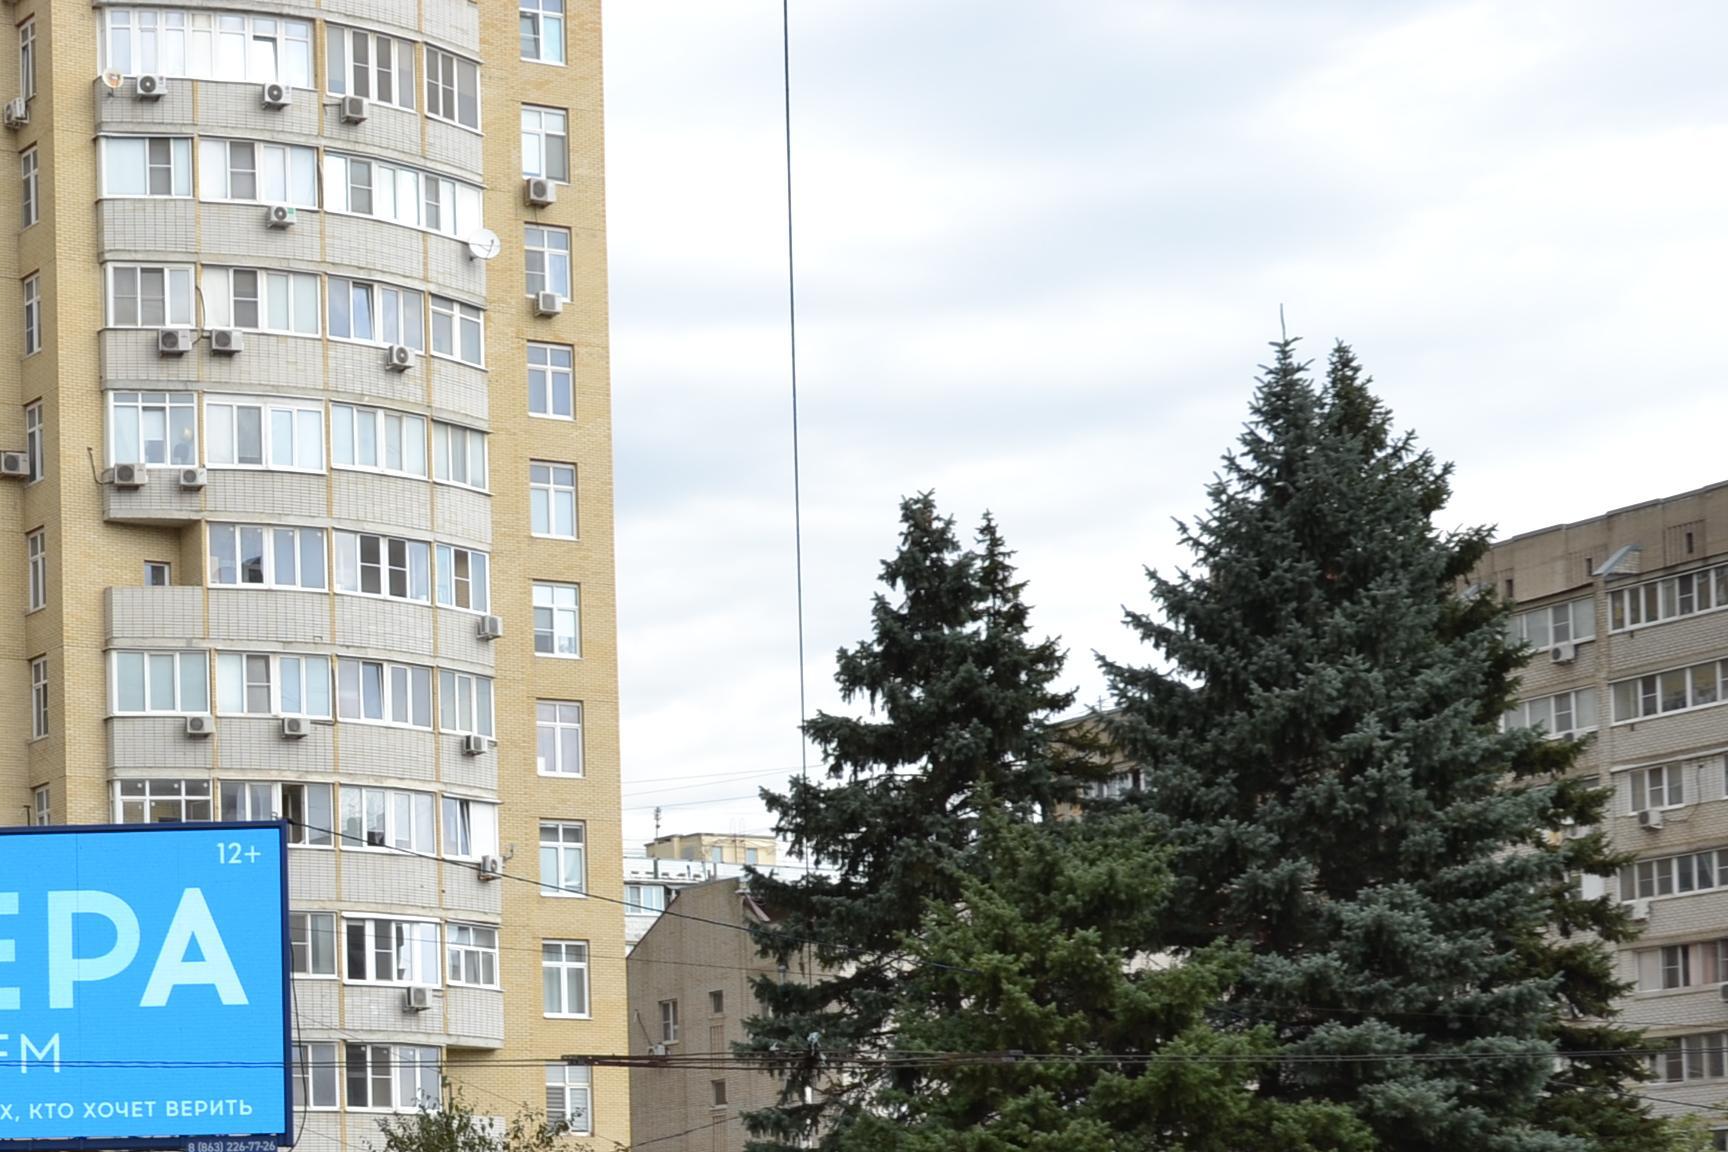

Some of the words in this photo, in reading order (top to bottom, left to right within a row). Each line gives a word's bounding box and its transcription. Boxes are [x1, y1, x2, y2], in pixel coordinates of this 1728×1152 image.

[216, 842, 262, 865] 12+
[29, 1102, 74, 1120] КТО
[83, 1101, 156, 1119] ХОЧЕТ
[165, 1099, 253, 1117] ВЕРИТЬ
[188, 1142, 195, 1152] 8
[226, 1140, 276, 1152] 226-77-26
